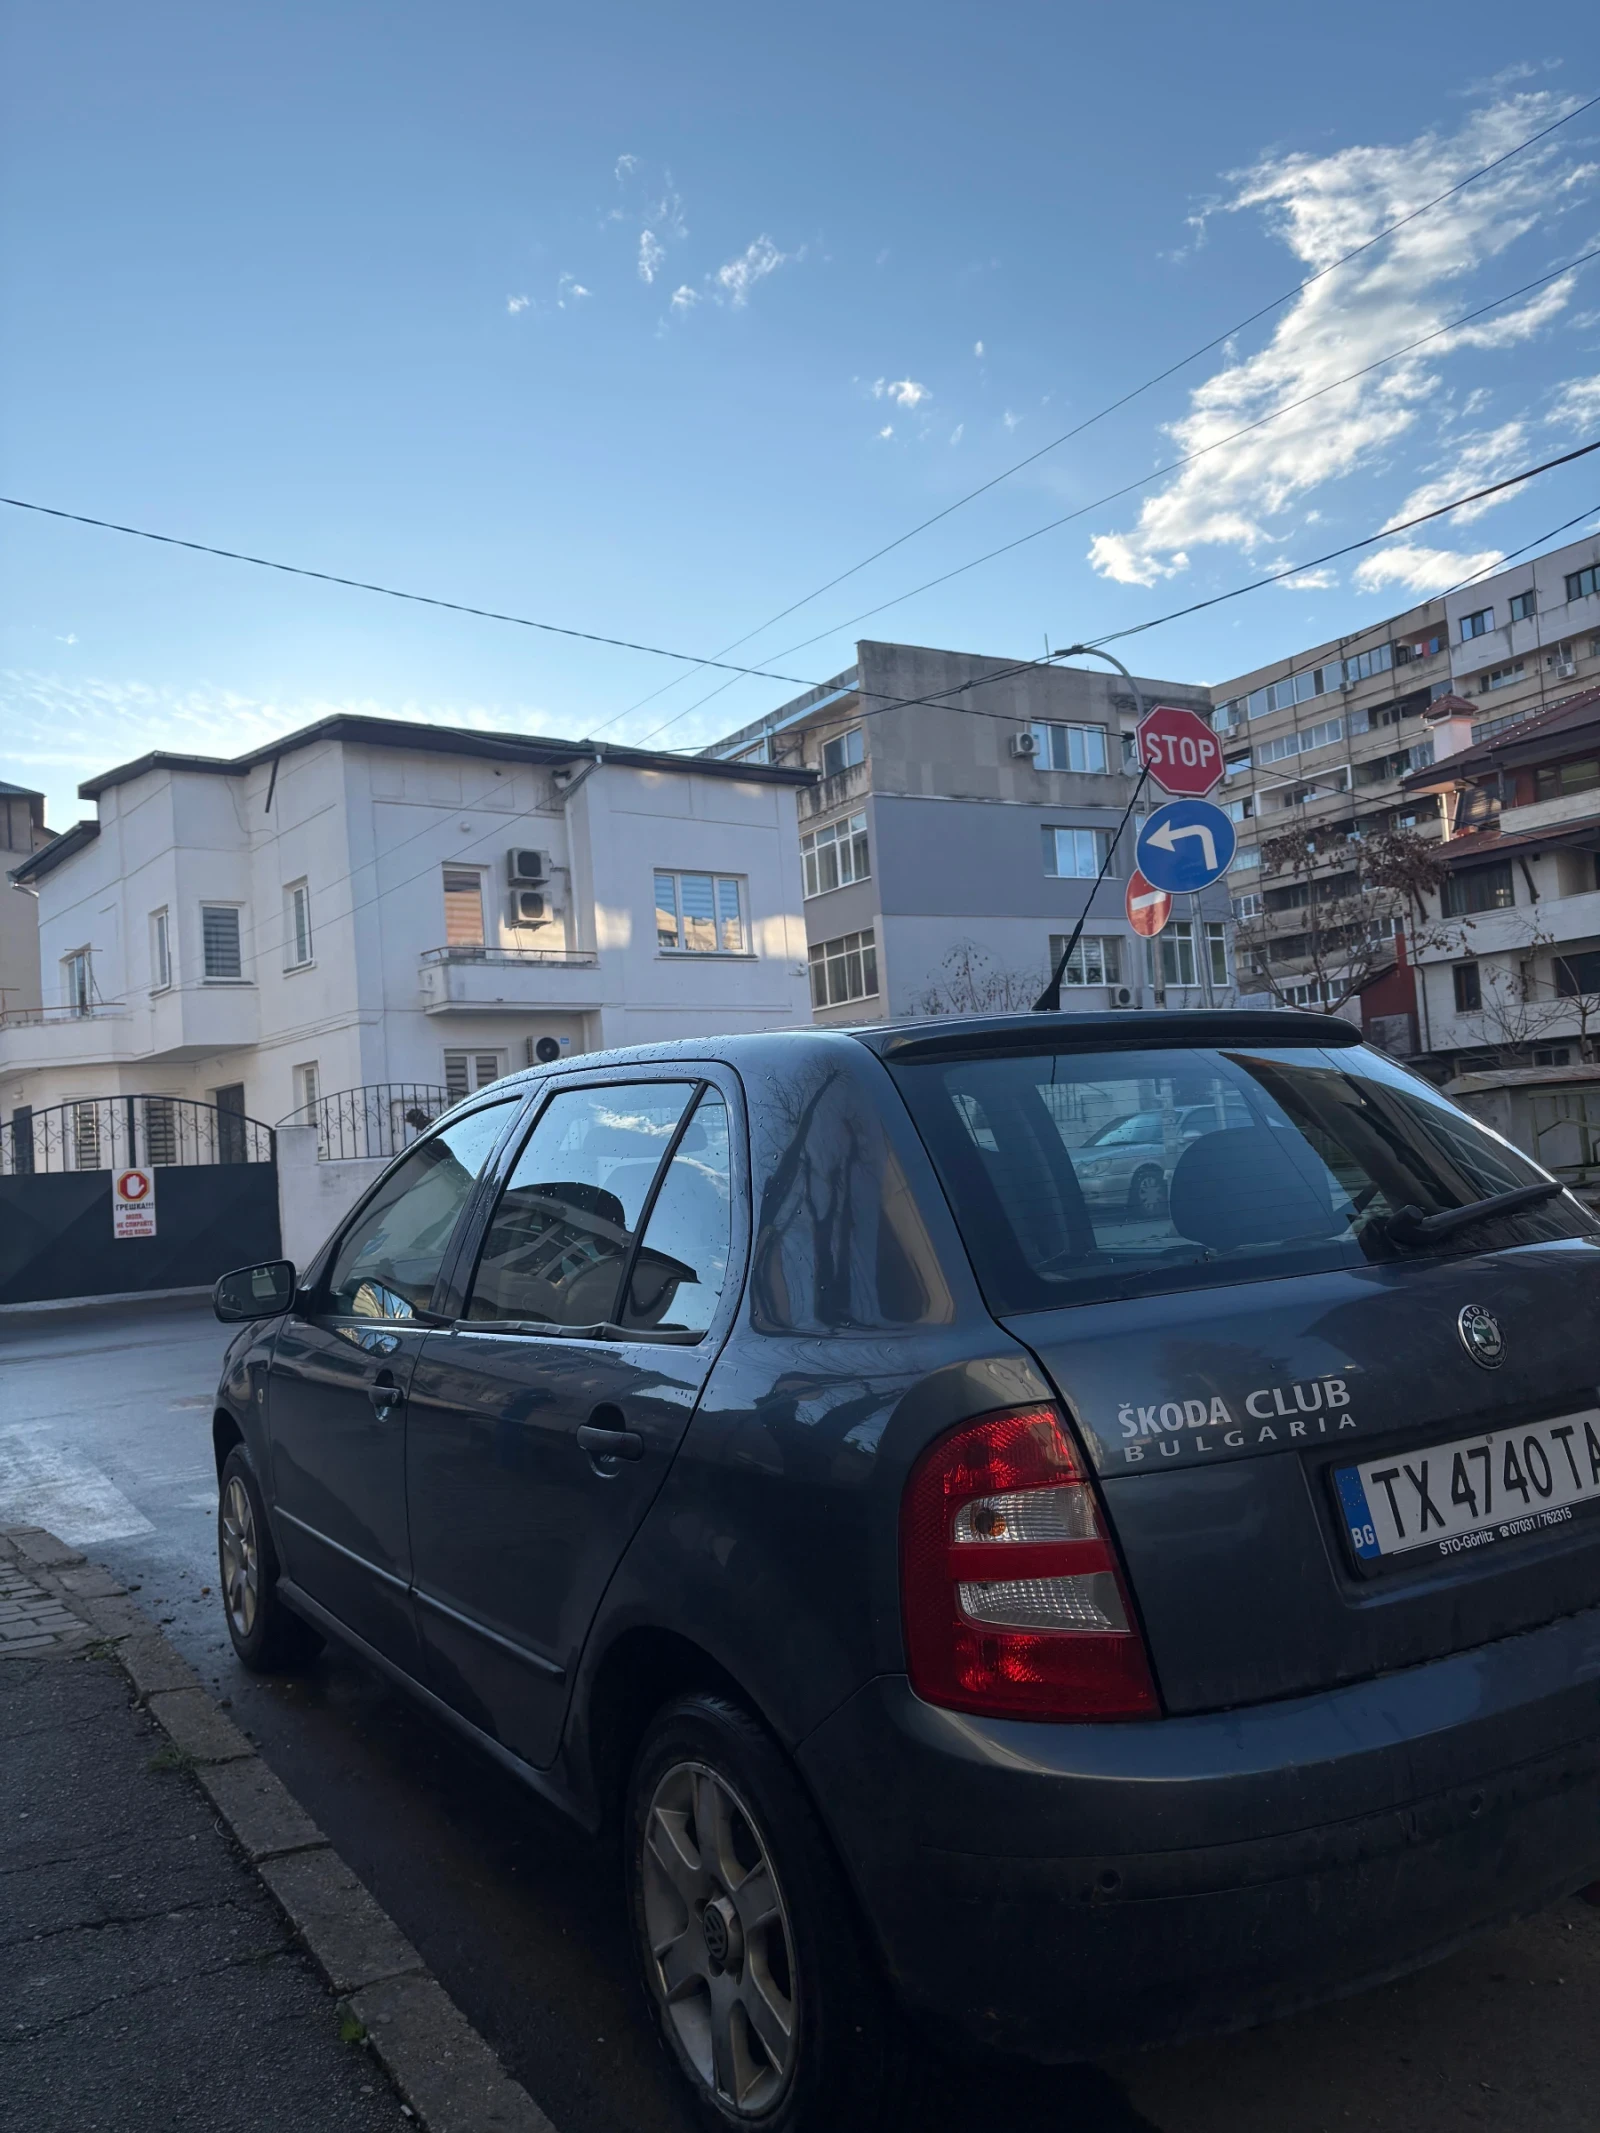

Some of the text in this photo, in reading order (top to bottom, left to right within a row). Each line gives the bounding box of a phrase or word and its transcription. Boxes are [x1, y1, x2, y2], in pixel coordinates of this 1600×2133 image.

[1145, 732, 1215, 768] STOP
[1118, 1379, 1351, 1438] ŠKODA CLUB
[1124, 1413, 1357, 1463] BULGARIA
[1370, 1460, 1446, 1538] TX
[1450, 1435, 1552, 1518] 4740
[1351, 1524, 1375, 1548] BG
[1439, 1531, 1495, 1555] STO-Görlitz
